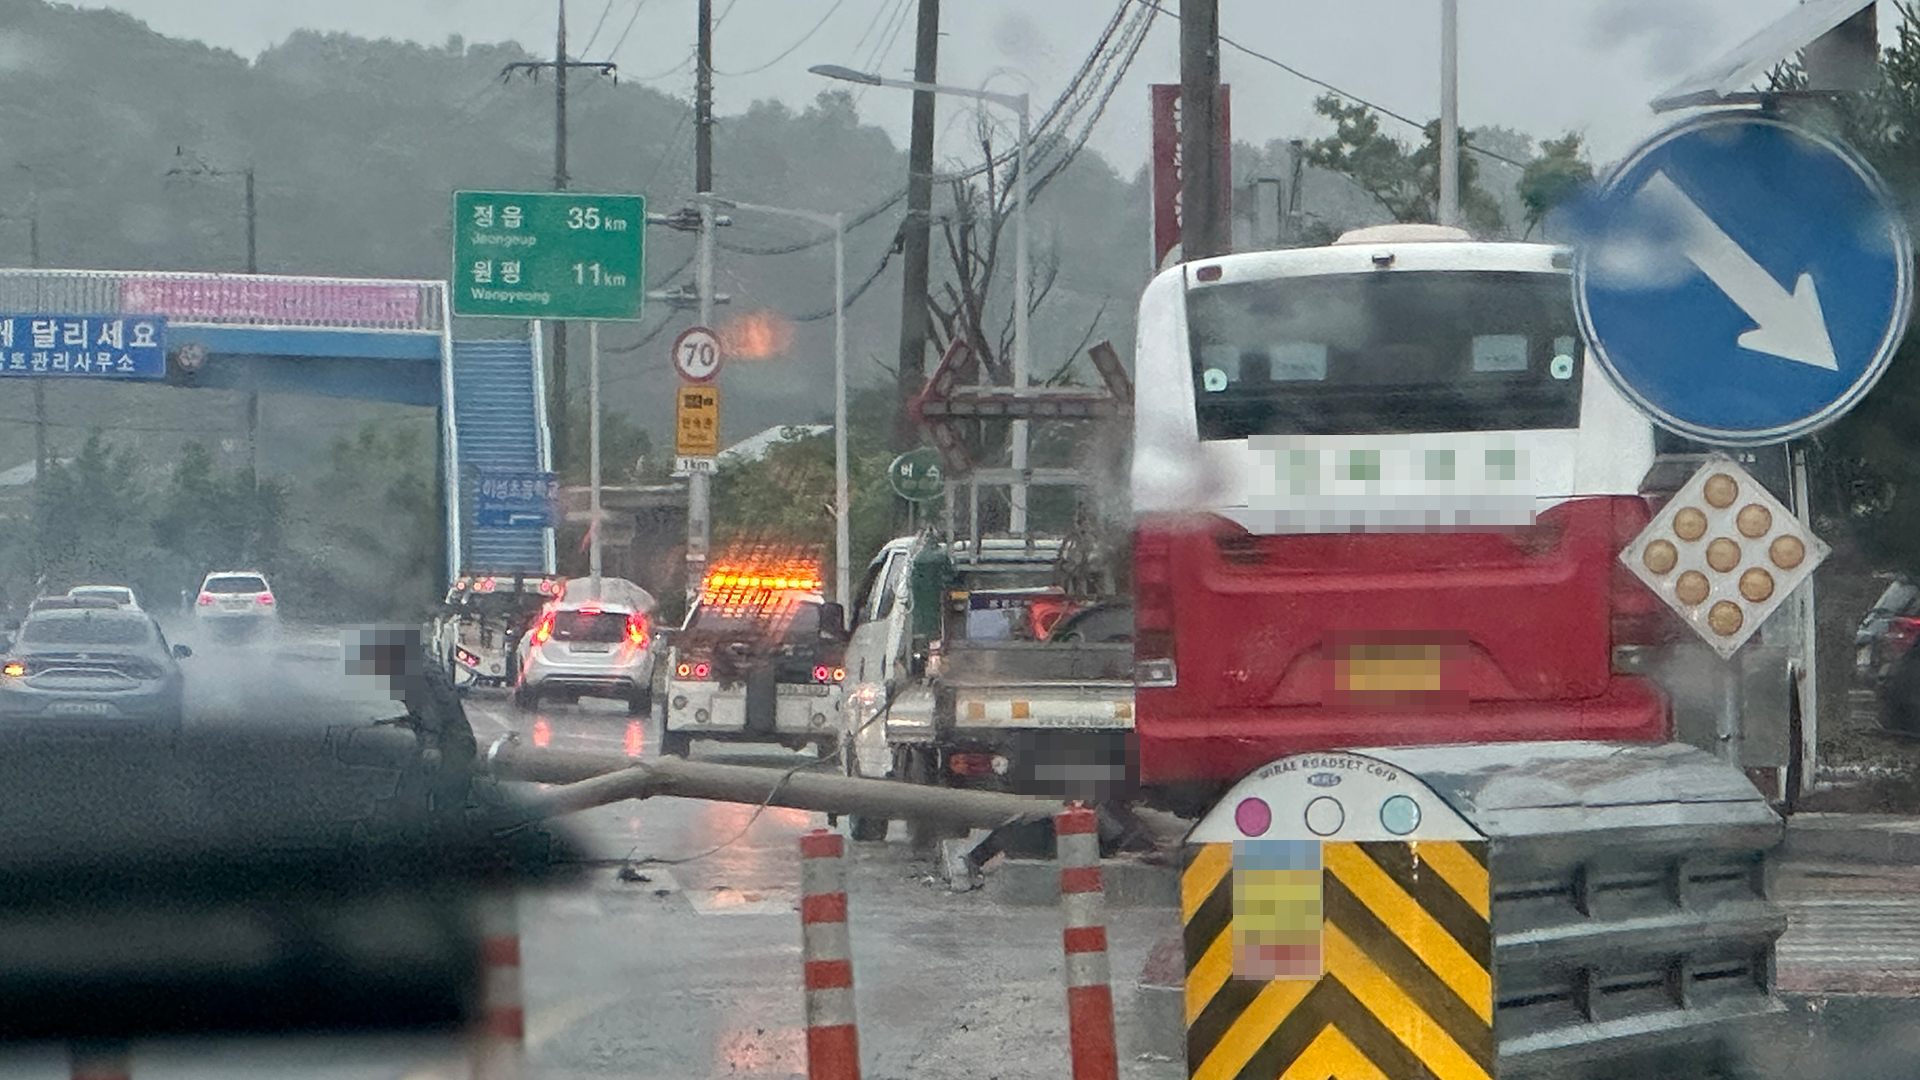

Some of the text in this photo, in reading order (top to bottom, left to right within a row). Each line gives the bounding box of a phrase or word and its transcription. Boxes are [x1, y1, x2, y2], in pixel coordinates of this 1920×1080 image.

[473, 205, 628, 231] 정읍 35 km
[471, 260, 627, 286] 원평 11 km
[32, 319, 157, 349] 달리세요
[684, 343, 715, 368] 70
[1302, 758, 1365, 771] ROADSET
